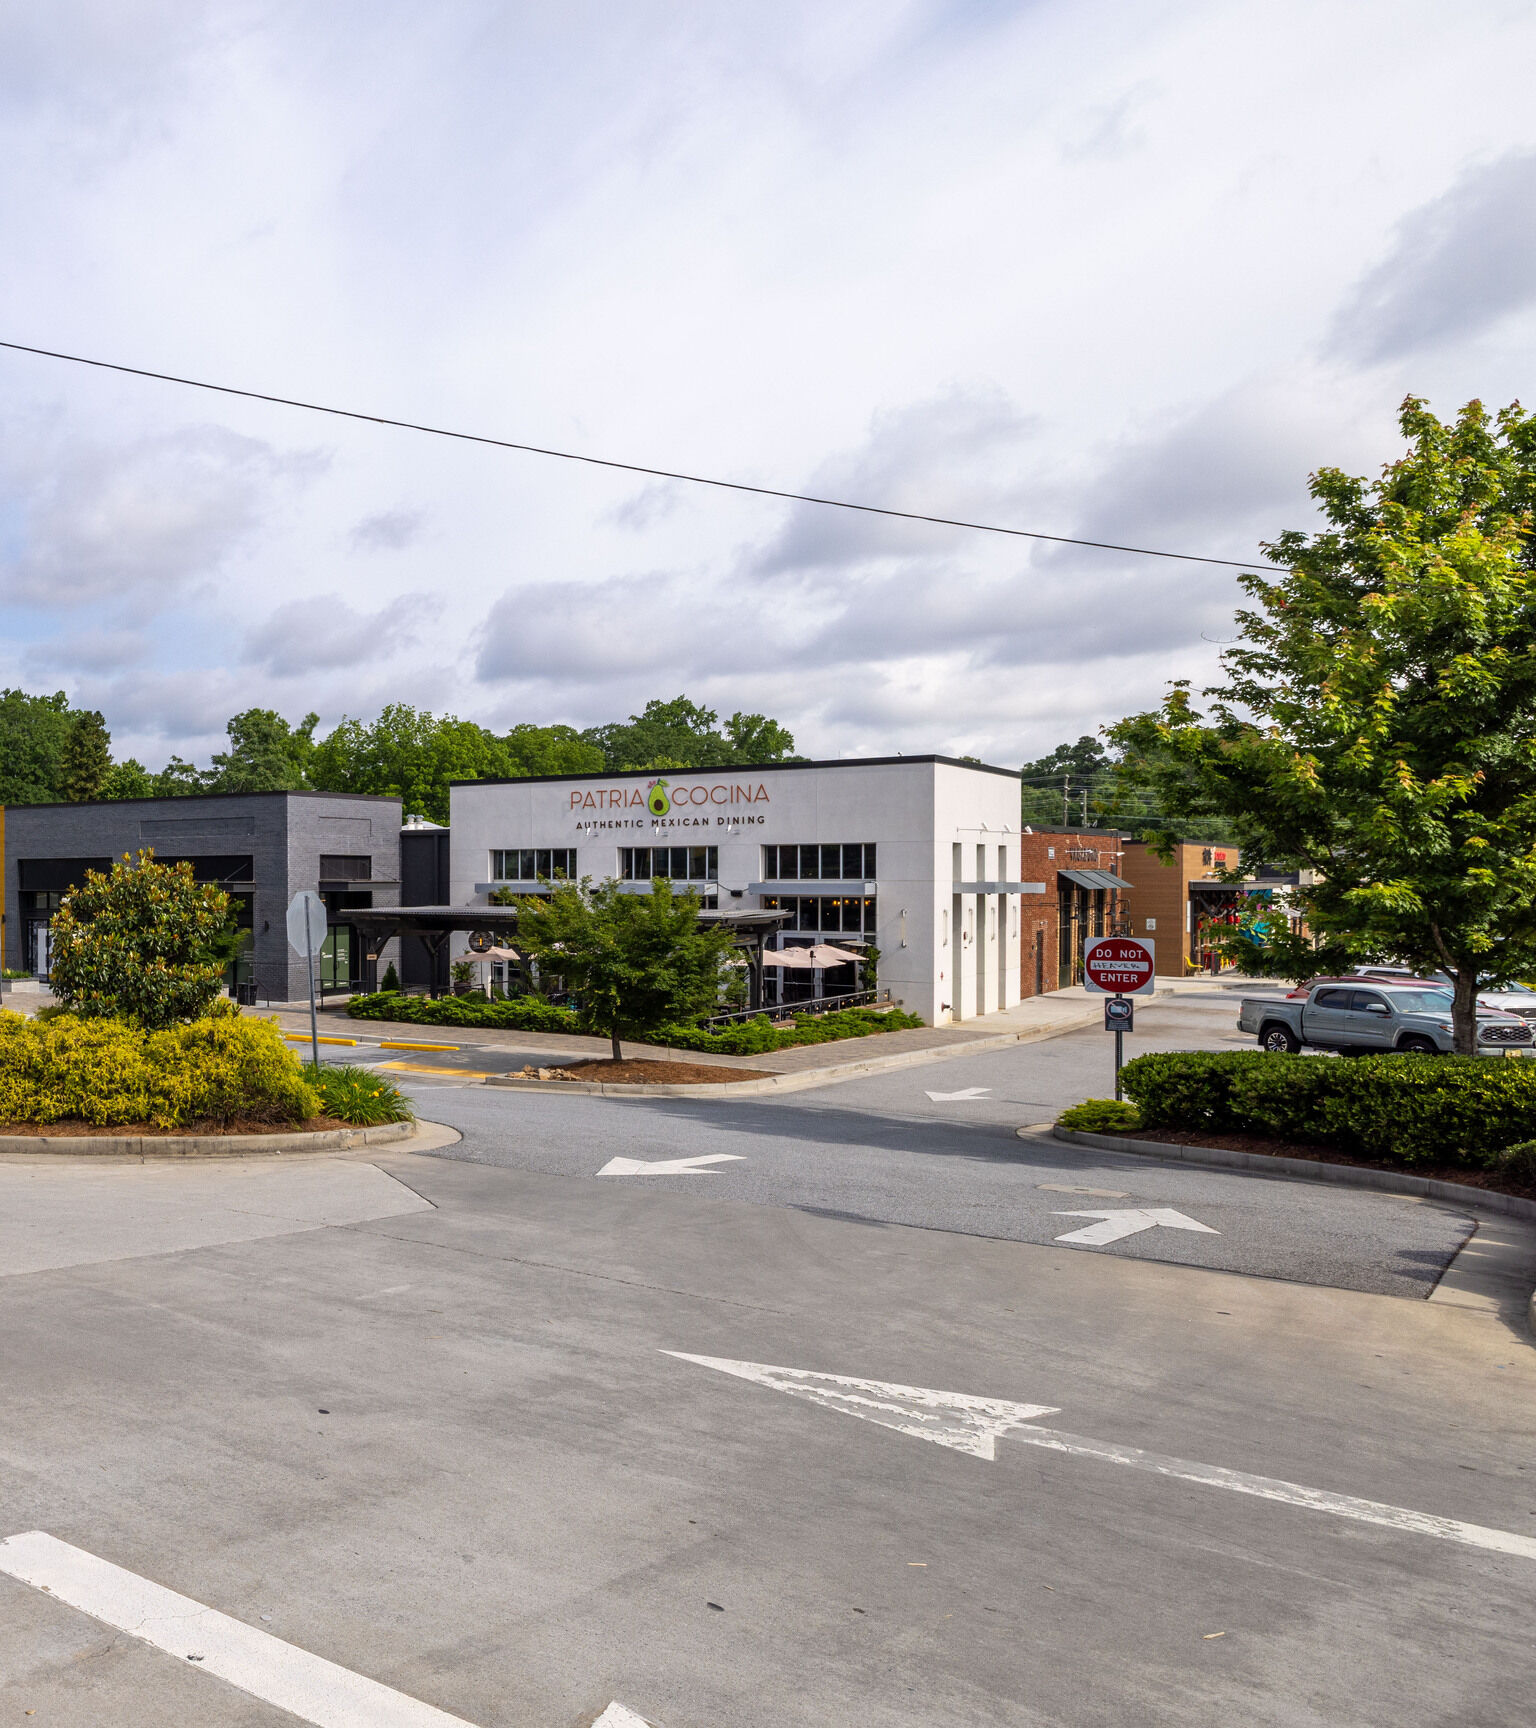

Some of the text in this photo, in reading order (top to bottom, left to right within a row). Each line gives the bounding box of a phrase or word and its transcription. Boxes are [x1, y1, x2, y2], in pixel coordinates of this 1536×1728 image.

[570, 783, 770, 810] PATRIA COCINA
[576, 815, 765, 830] AUTHENTIC MEXICAN DINING
[1096, 949, 1143, 959] DO NOT
[1100, 973, 1138, 983] ENTER
